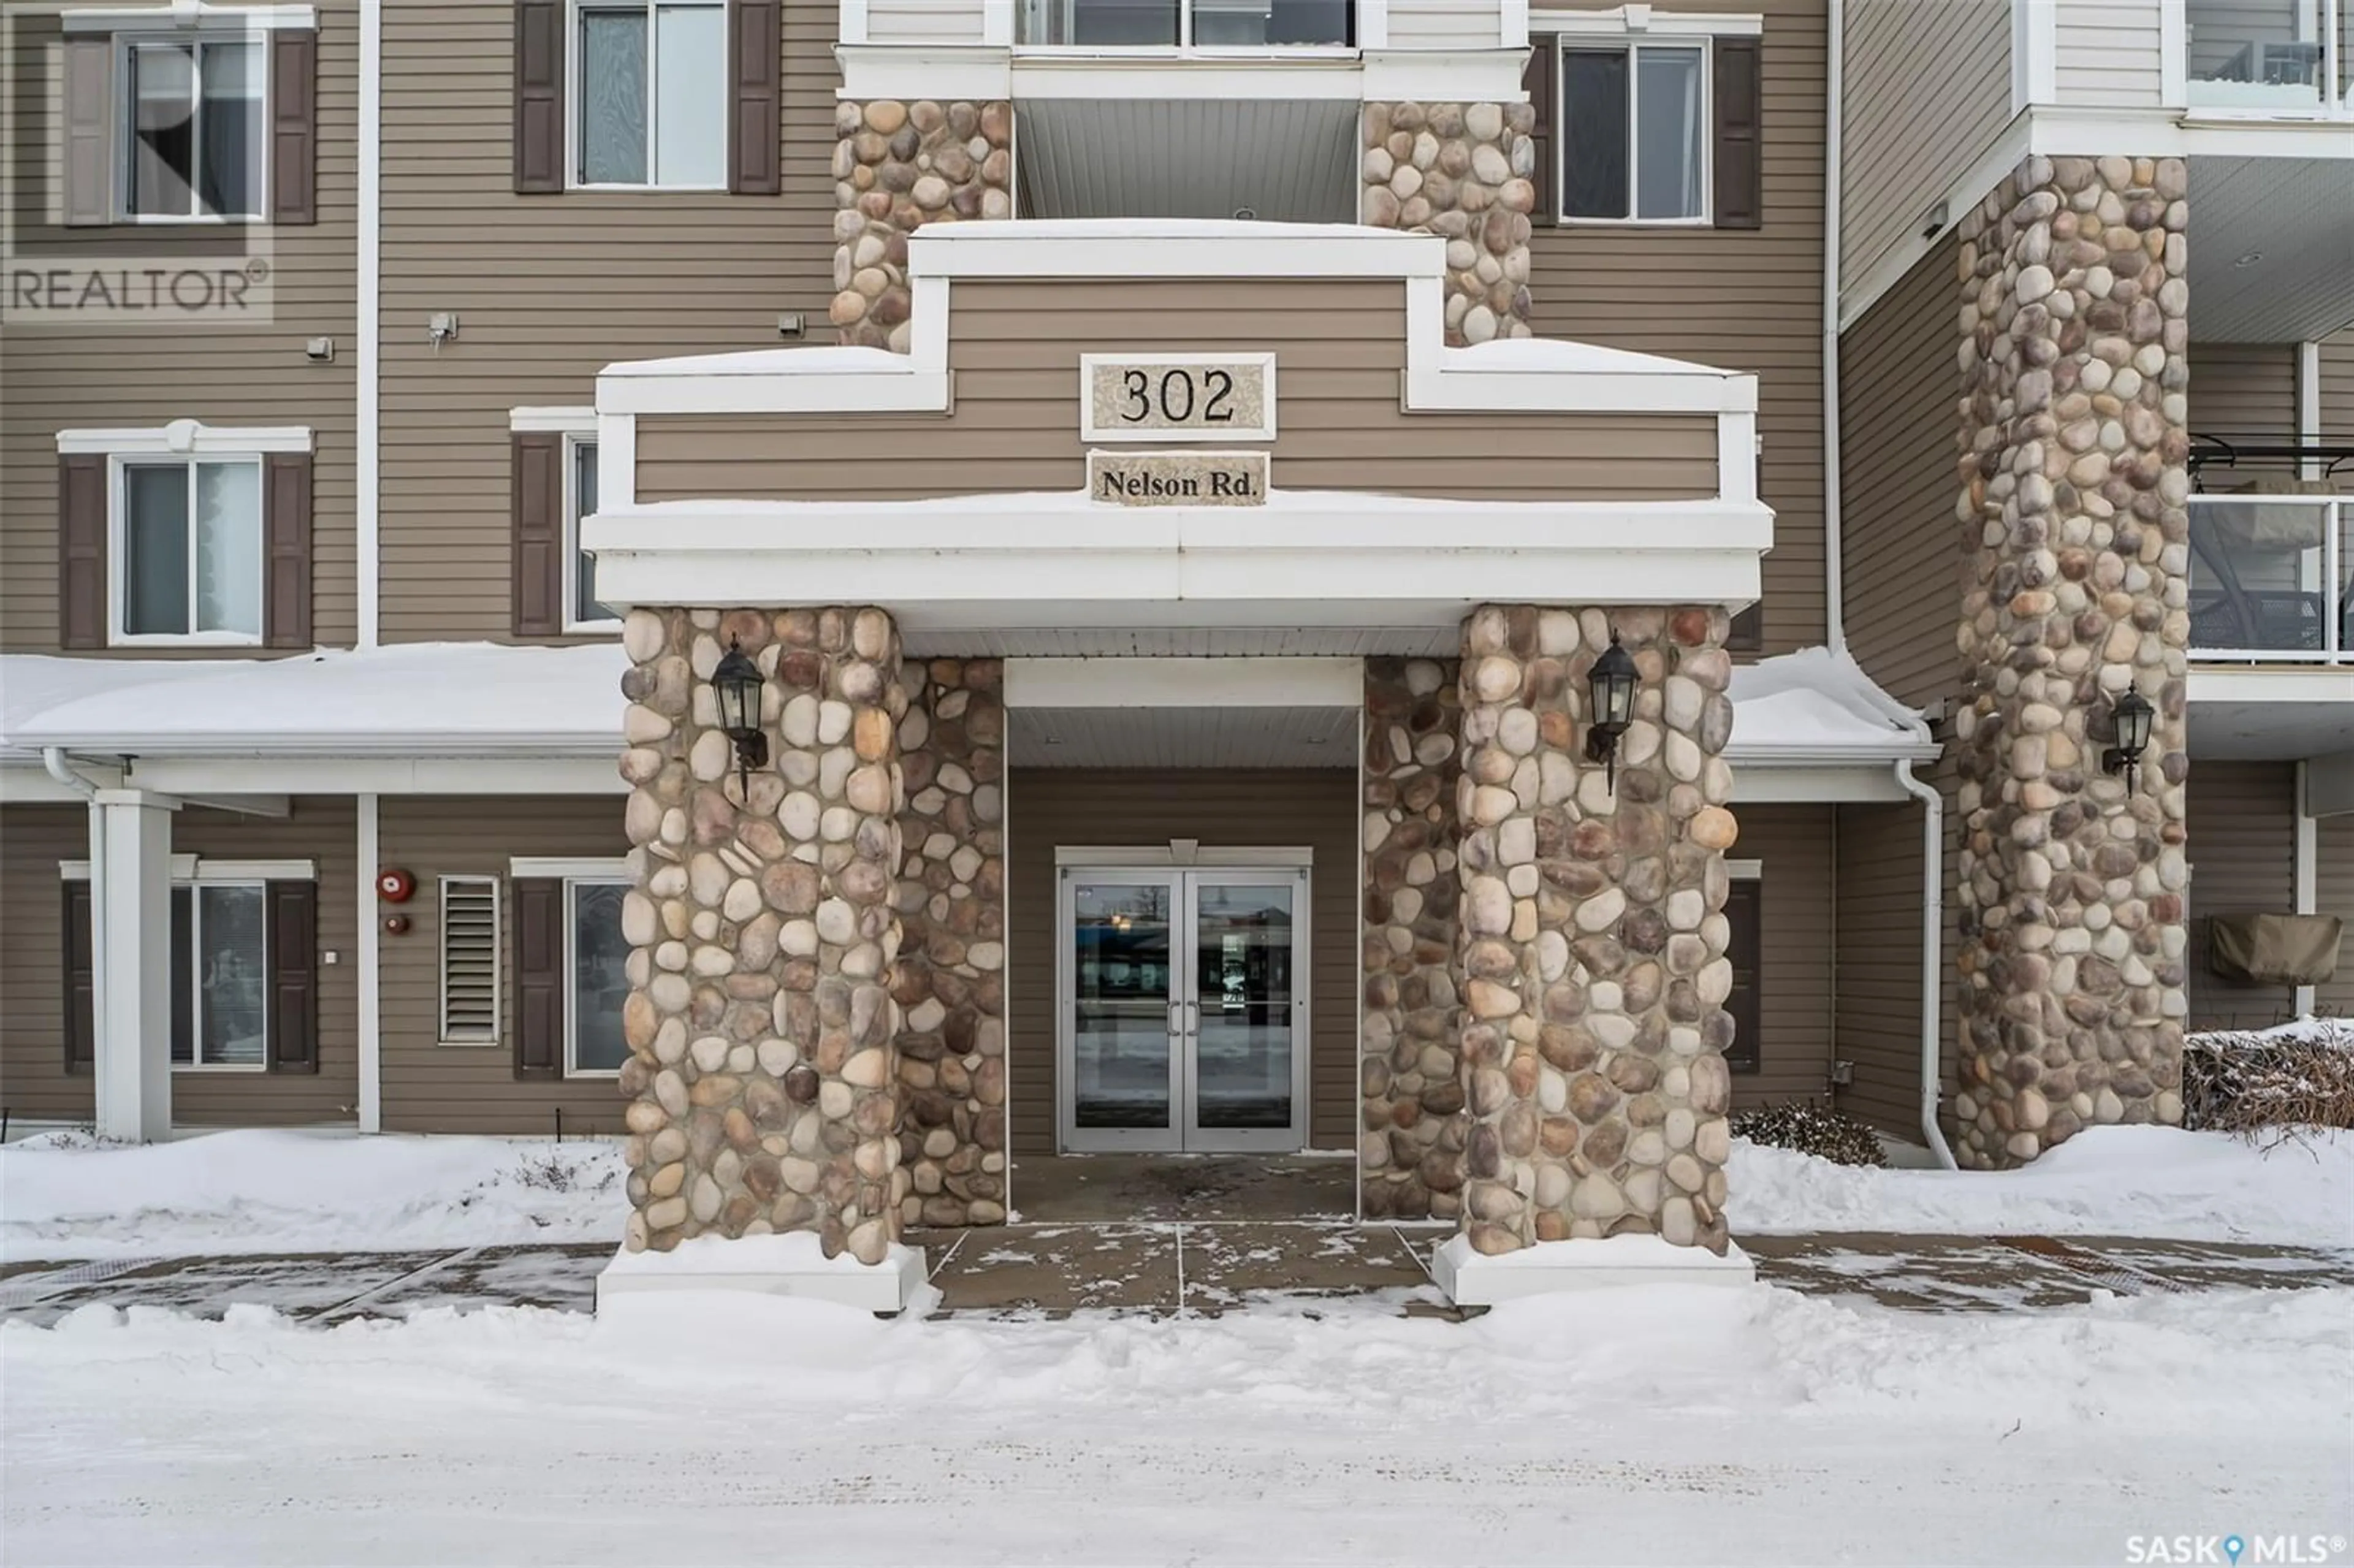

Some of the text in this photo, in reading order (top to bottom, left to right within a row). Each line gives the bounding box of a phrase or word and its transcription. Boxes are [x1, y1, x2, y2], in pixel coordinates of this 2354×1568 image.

[1121, 369, 1233, 422] 302
[1103, 471, 1257, 497] Nelson Rd.
